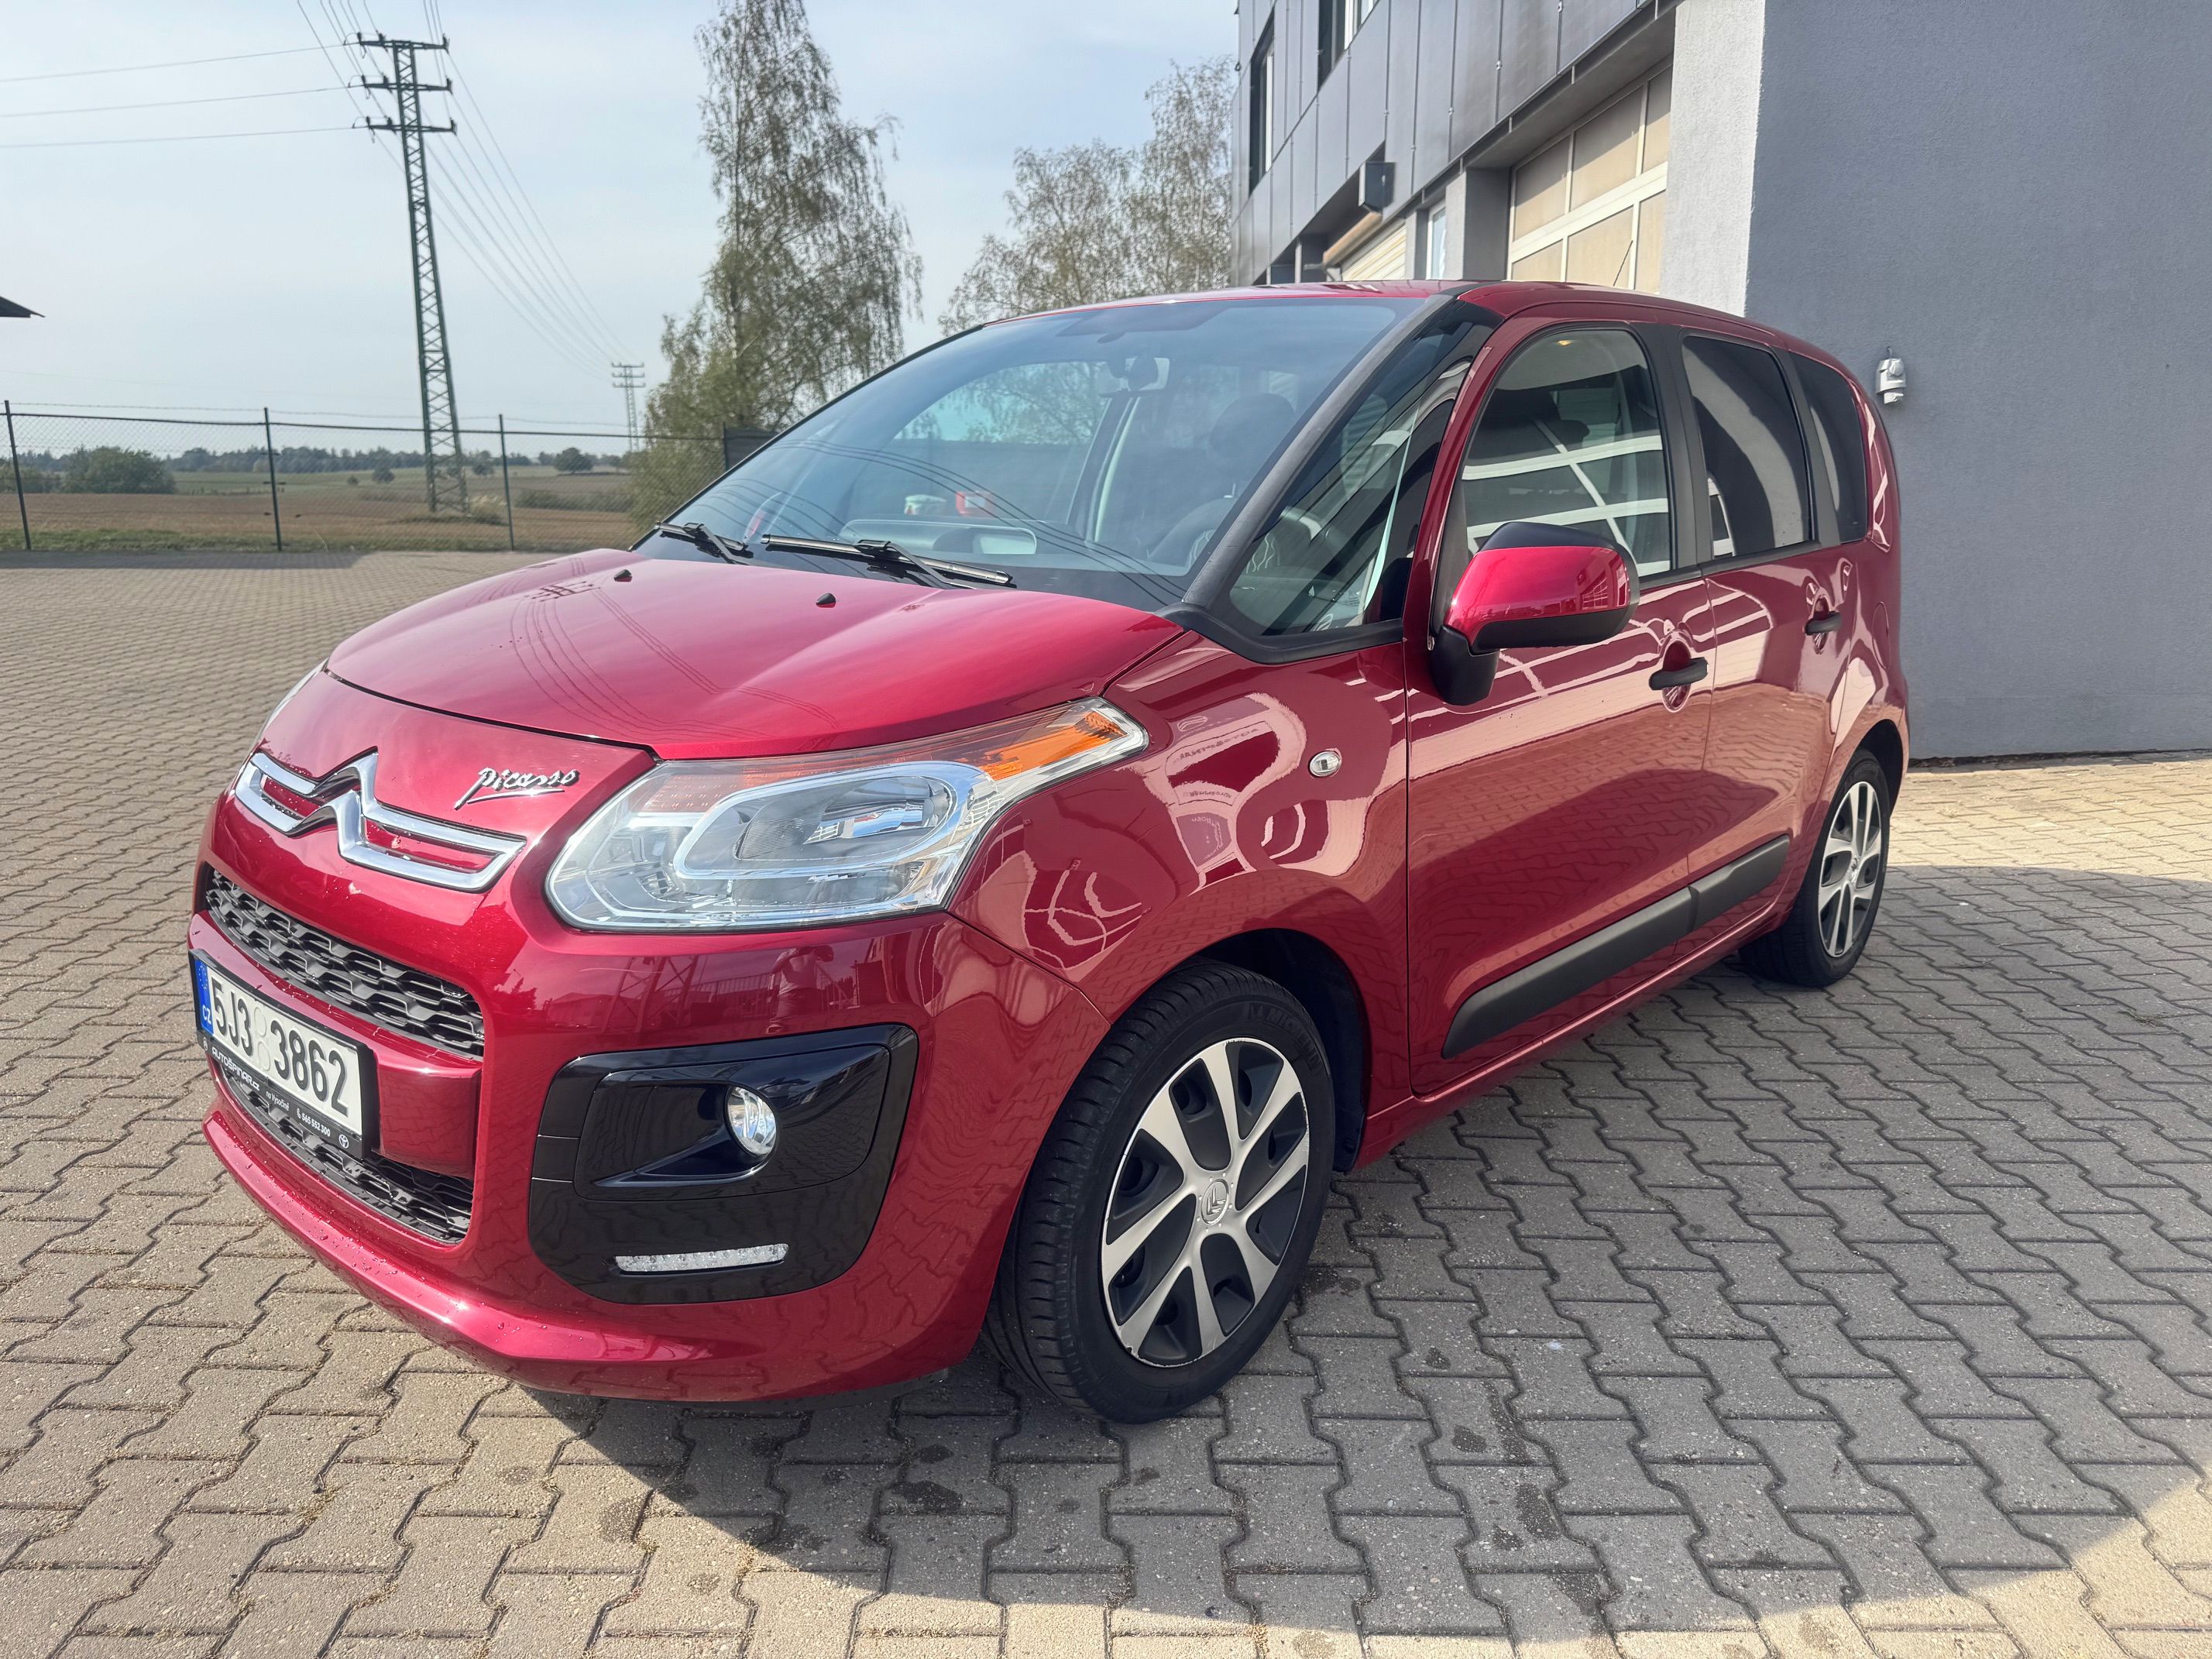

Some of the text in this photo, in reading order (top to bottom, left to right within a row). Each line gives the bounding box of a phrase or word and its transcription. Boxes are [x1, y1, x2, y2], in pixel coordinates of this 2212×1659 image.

[454, 767, 580, 810] Picasso
[202, 1004, 212, 1025] CZ
[211, 977, 348, 1117] 5J3 3862
[311, 1118, 321, 1131] 552
